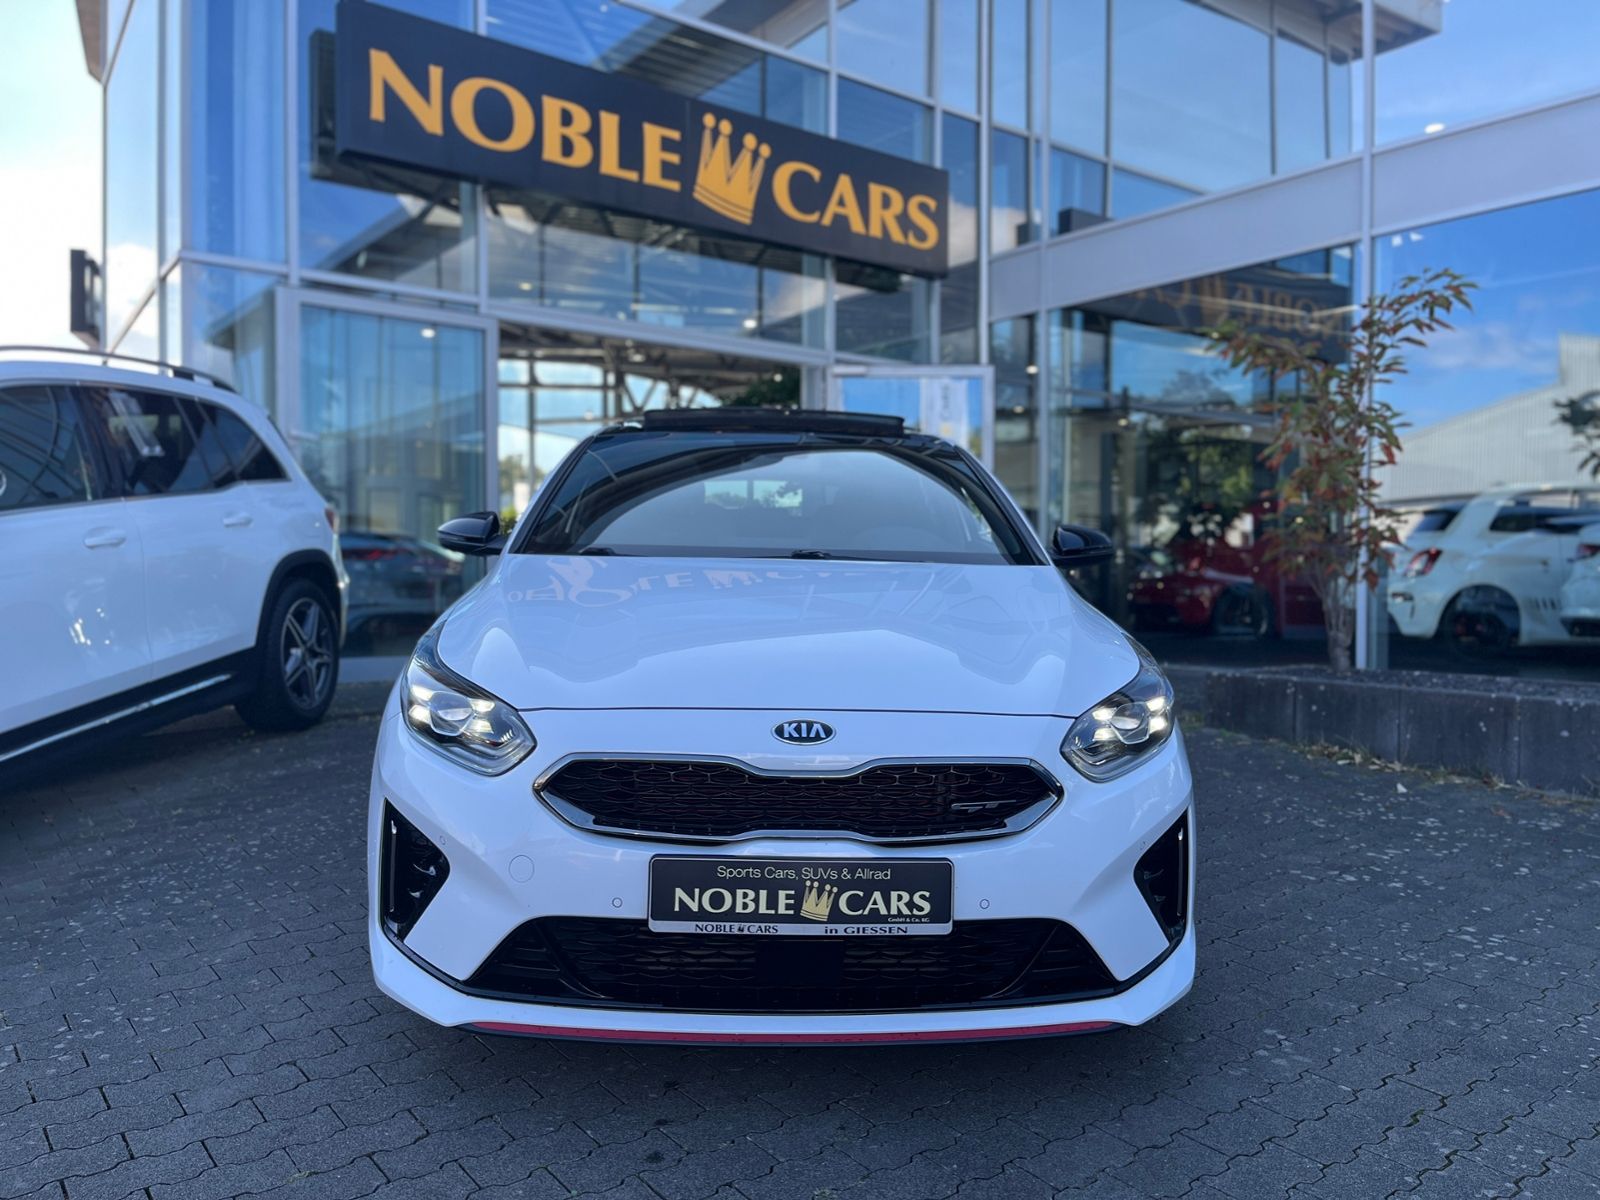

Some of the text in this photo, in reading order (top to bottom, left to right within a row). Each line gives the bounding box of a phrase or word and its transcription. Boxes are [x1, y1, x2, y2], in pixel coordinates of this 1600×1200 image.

[368, 47, 940, 250] NOBLE CARS
[783, 722, 827, 738] KIA
[717, 865, 891, 880] Sports Cars, SUVs & Allrad
[673, 887, 931, 916] NOBLE CARS
[694, 923, 909, 935] NOBLE CARS in GIESSEN
